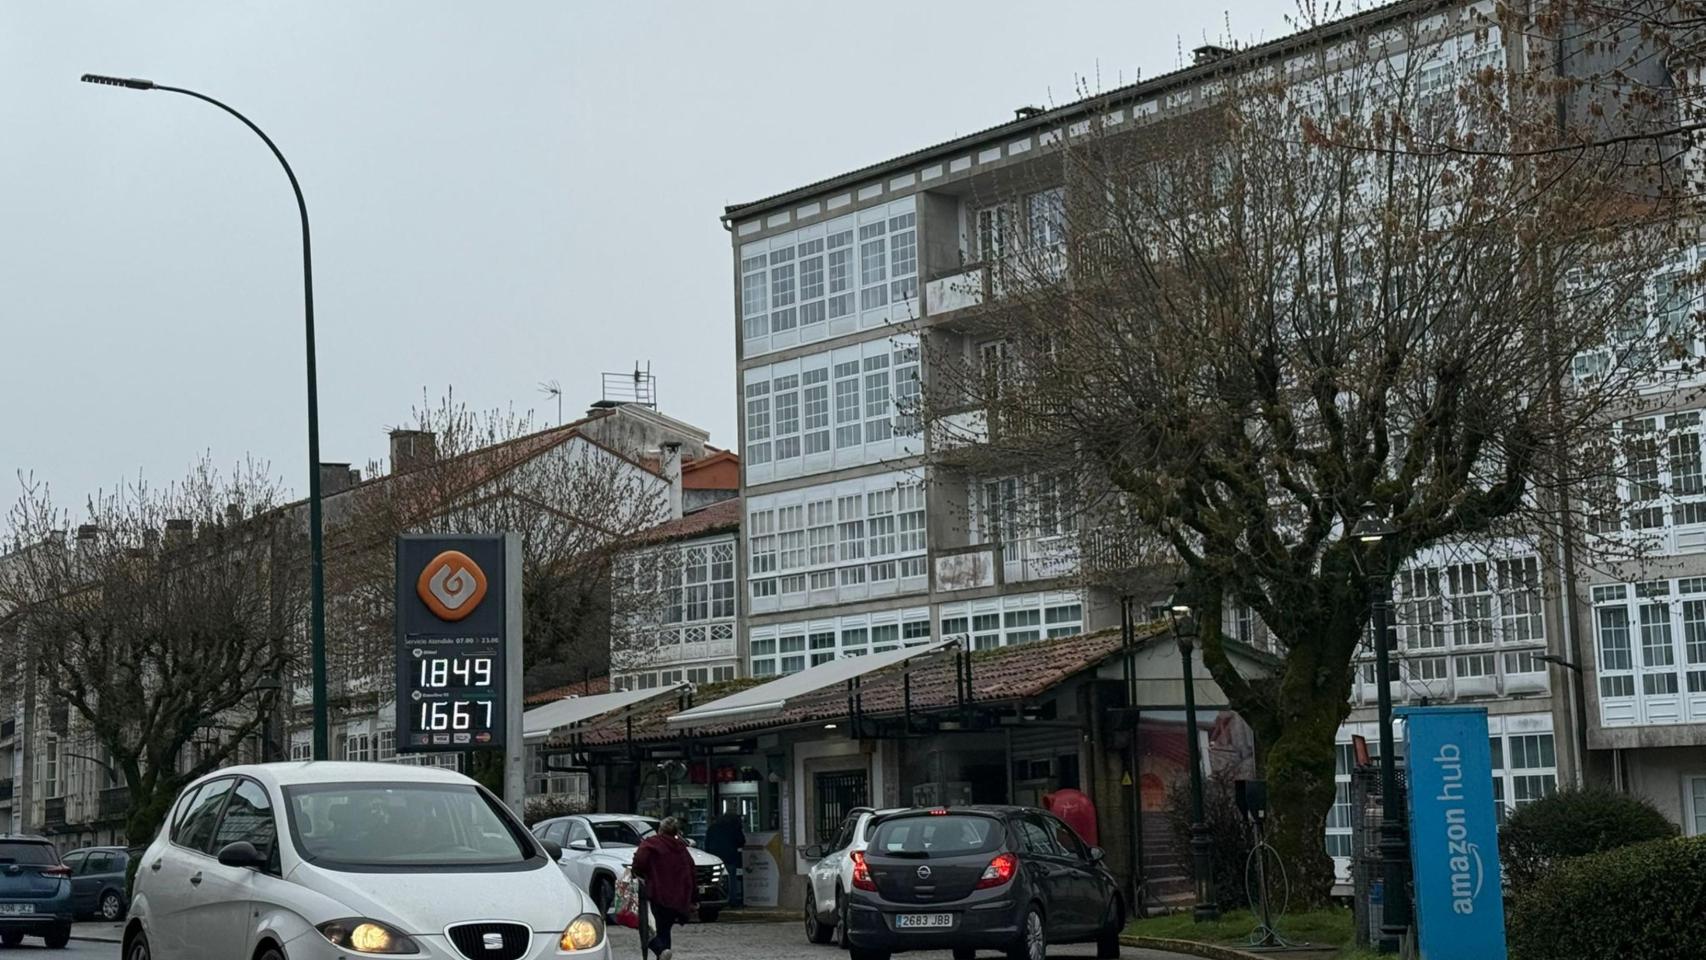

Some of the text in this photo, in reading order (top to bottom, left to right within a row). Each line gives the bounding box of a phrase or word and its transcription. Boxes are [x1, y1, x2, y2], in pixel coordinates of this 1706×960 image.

[421, 658, 491, 687] 1.849
[421, 700, 492, 730] 1.667
[1433, 743, 1474, 915] amazon hub
[903, 915, 950, 926] 2683 JBB
